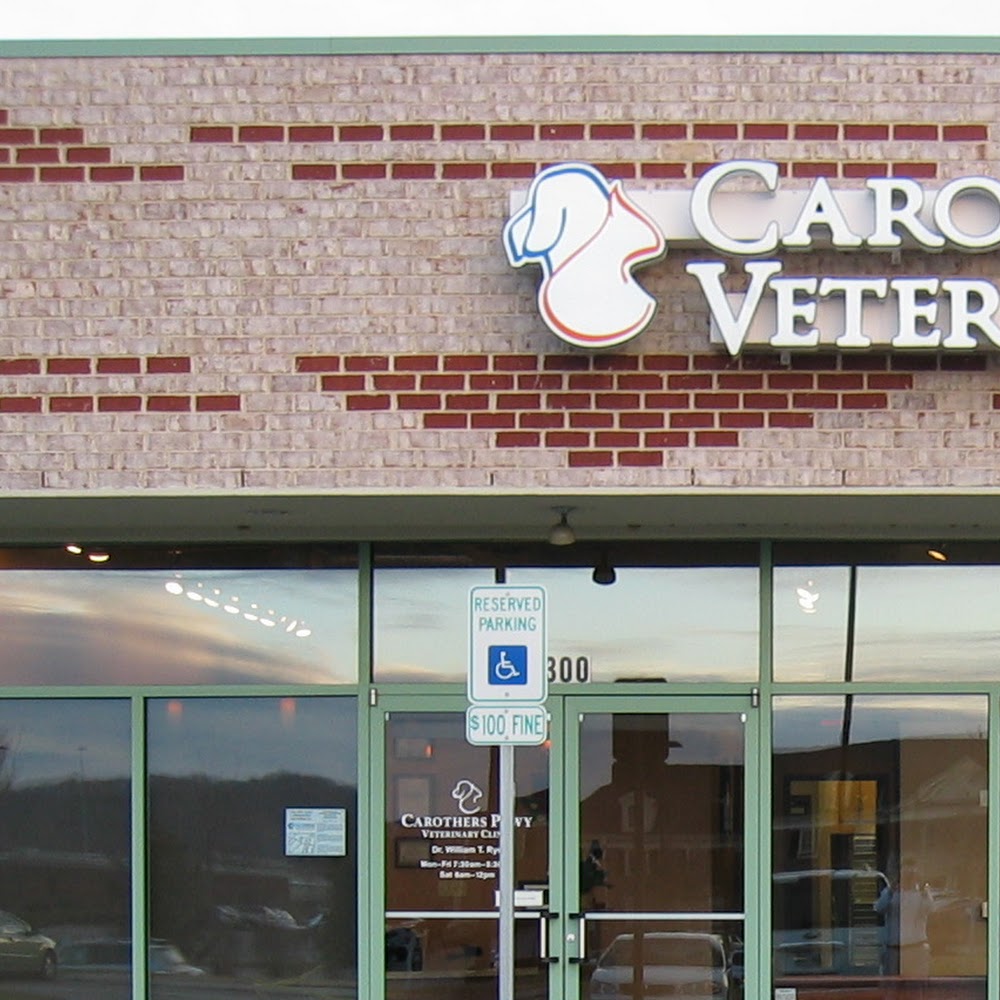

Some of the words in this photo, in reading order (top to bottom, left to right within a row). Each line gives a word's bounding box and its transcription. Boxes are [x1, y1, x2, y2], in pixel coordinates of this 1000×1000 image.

[474, 597, 541, 612] RESERVED
[479, 617, 537, 632] PARKING
[470, 715, 506, 736] $100
[512, 715, 544, 736] FINE
[401, 813, 487, 828] CAROTHERS
[491, 813, 532, 828] PWY
[421, 829, 480, 839] VETERINARY
